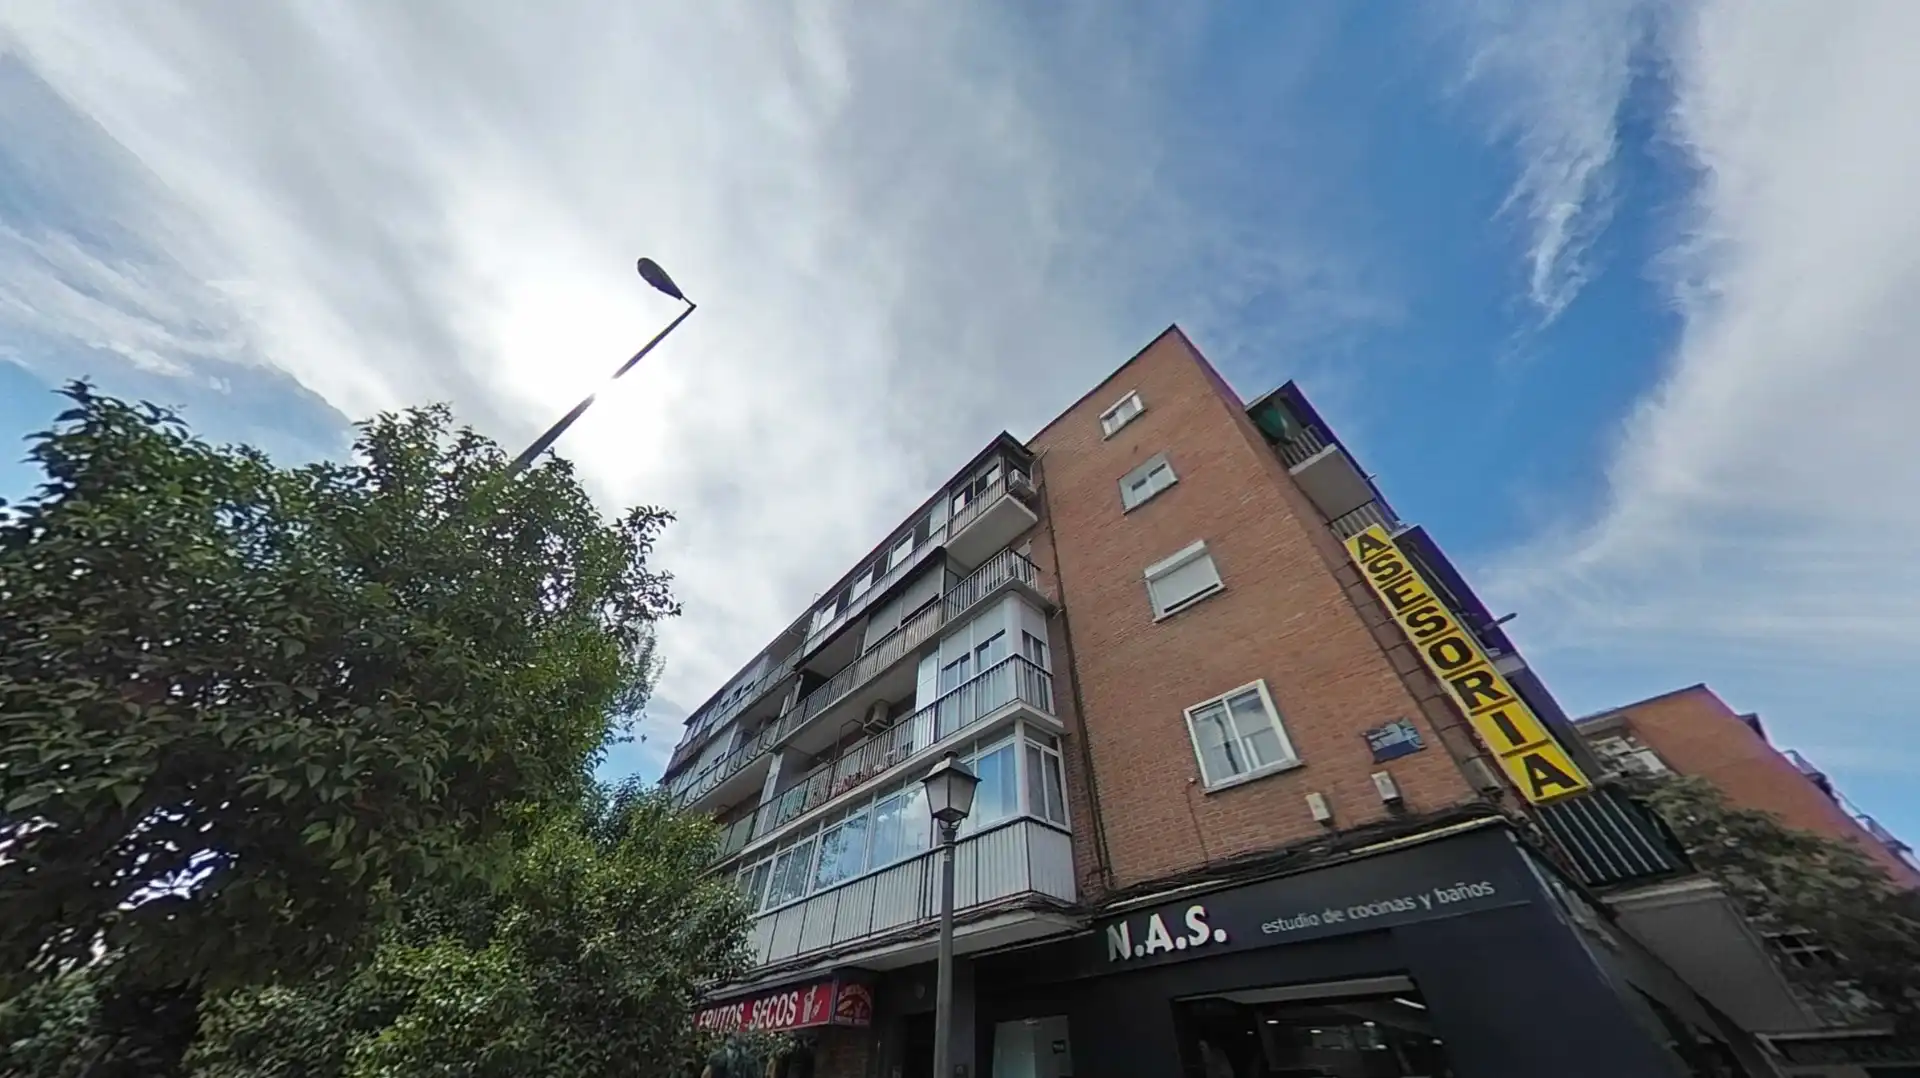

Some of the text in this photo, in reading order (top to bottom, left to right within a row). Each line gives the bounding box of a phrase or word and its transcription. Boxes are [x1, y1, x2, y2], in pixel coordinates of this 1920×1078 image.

[1356, 532, 1580, 797] ASESORIA
[1107, 905, 1226, 962] N.A.S.
[1261, 879, 1496, 934] estudio de cocinas y baños
[750, 991, 799, 1030] SECOS
